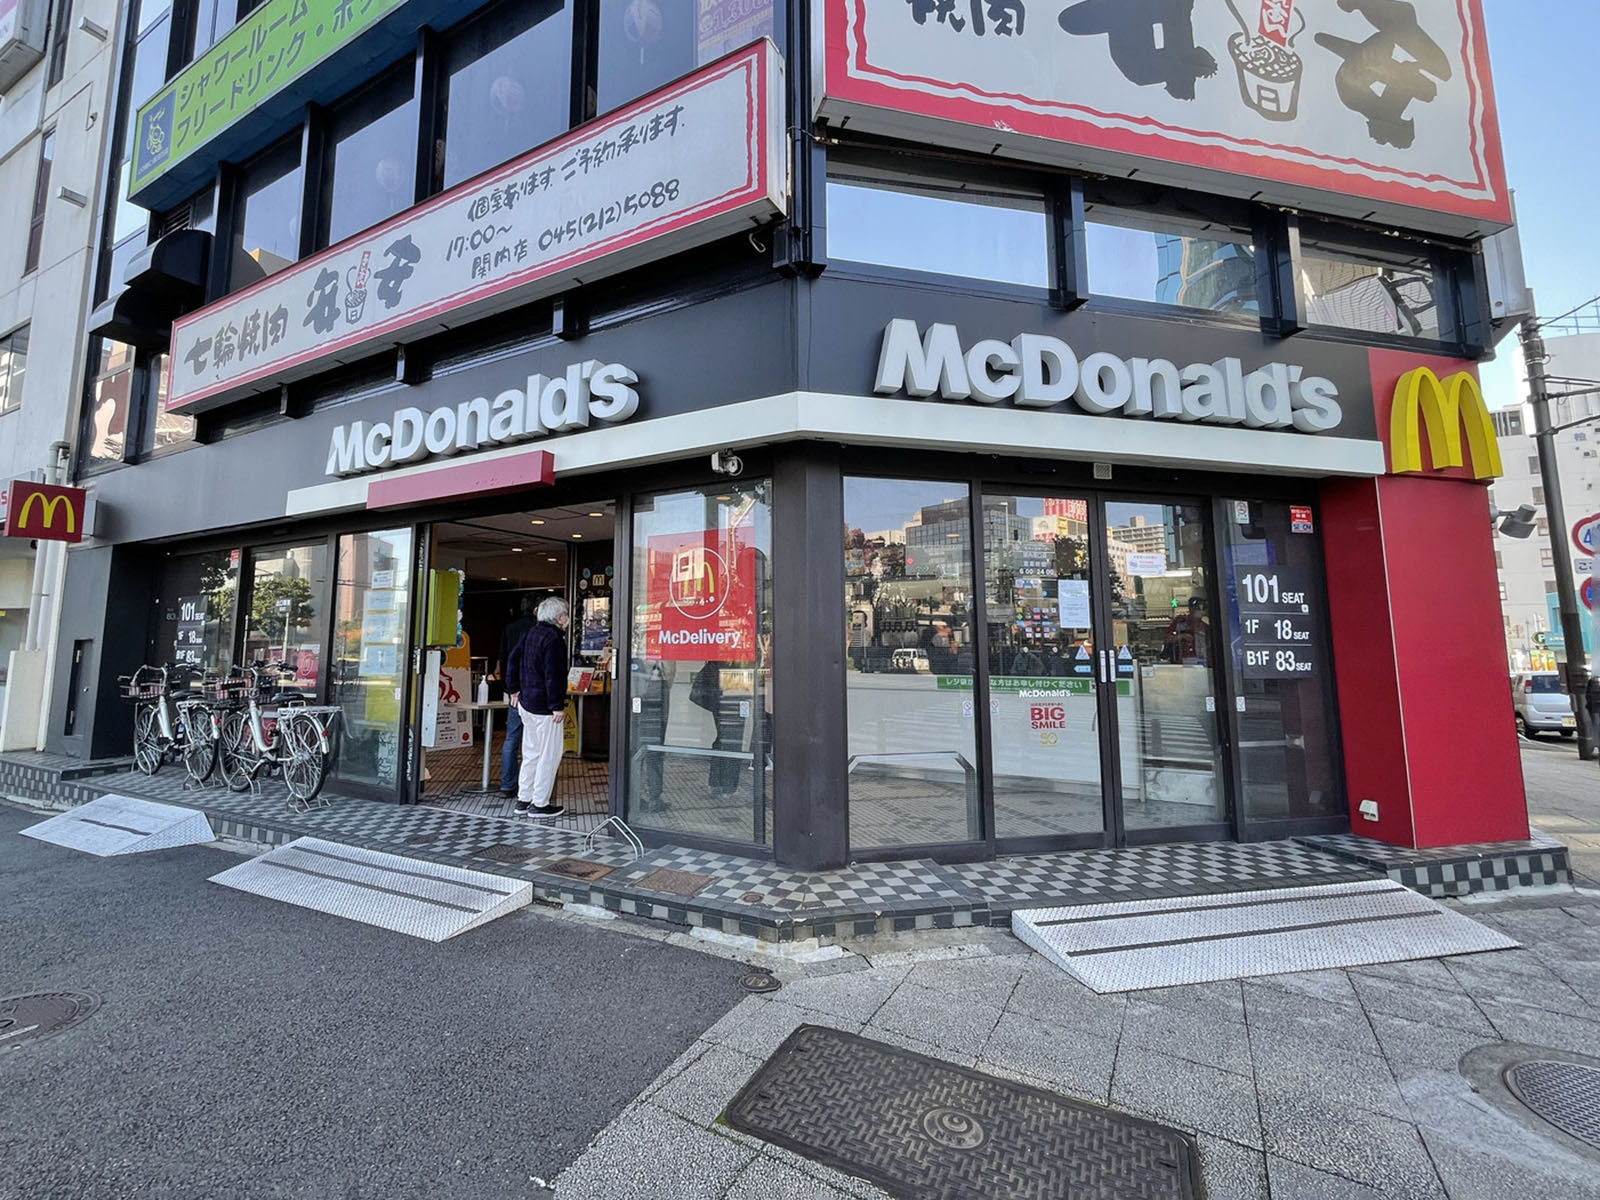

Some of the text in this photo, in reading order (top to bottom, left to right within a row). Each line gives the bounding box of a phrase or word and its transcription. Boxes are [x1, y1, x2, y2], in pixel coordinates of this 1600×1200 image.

[538, 178, 680, 251] 045(212)5088
[873, 318, 1342, 434] McDonald's
[325, 359, 640, 477] McDonald's
[1242, 574, 1304, 604] 101 SEAT
[181, 602, 195, 621] 101
[658, 628, 741, 648] McDelivery
[1245, 619, 1310, 641] 1F 18 SEAT
[1246, 650, 1312, 672] B1F 83 SEAT
[1019, 689, 1071, 698] McDonald's
[1030, 707, 1066, 721] BIG
[1031, 721, 1066, 730] SMILE
